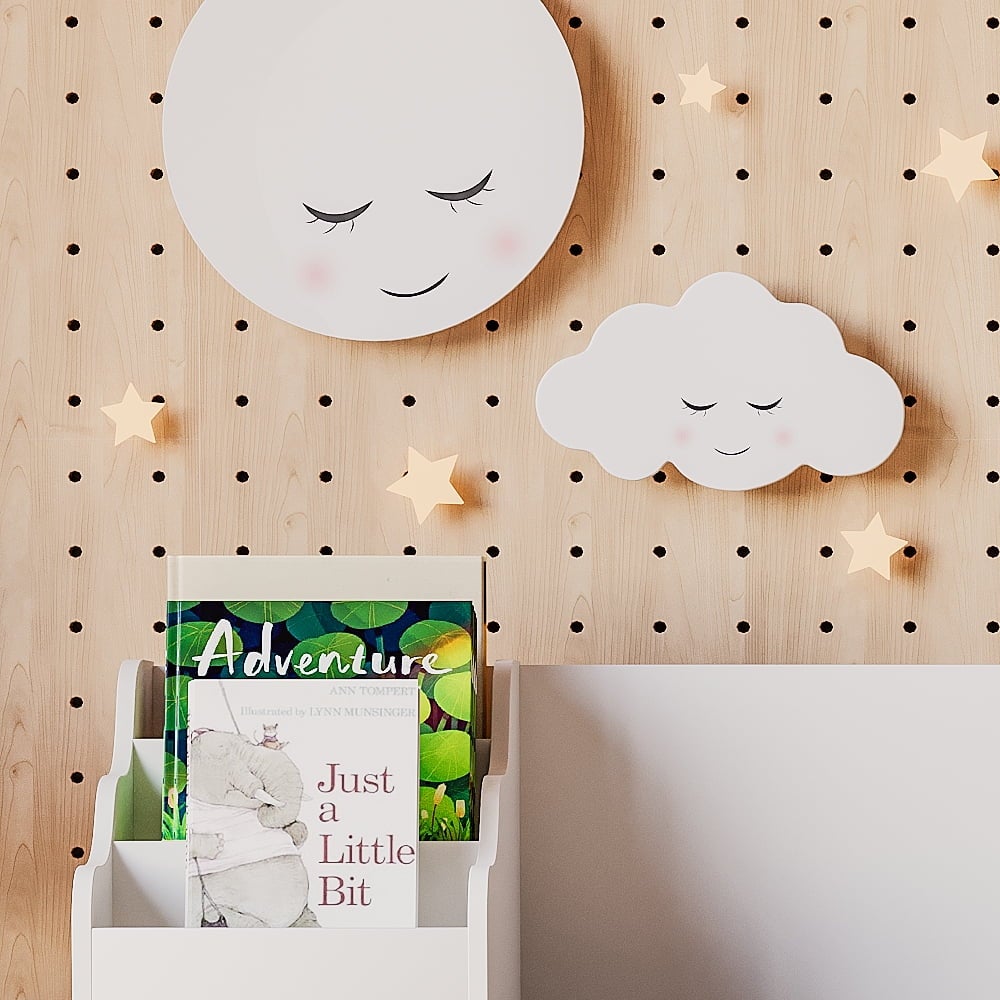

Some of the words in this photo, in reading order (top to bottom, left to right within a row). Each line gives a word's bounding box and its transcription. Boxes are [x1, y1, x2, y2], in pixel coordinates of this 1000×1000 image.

[191, 618, 453, 677] Adventure
[329, 686, 357, 697] ANN
[359, 686, 416, 697] TOMPERT
[240, 706, 293, 717] Illustrated
[295, 706, 307, 719] by
[309, 707, 343, 718] LYNN
[345, 707, 416, 718] MUNSINGER
[317, 763, 395, 794] Just
[318, 801, 339, 822] a
[318, 834, 415, 865] Little
[318, 876, 372, 906] Bit
